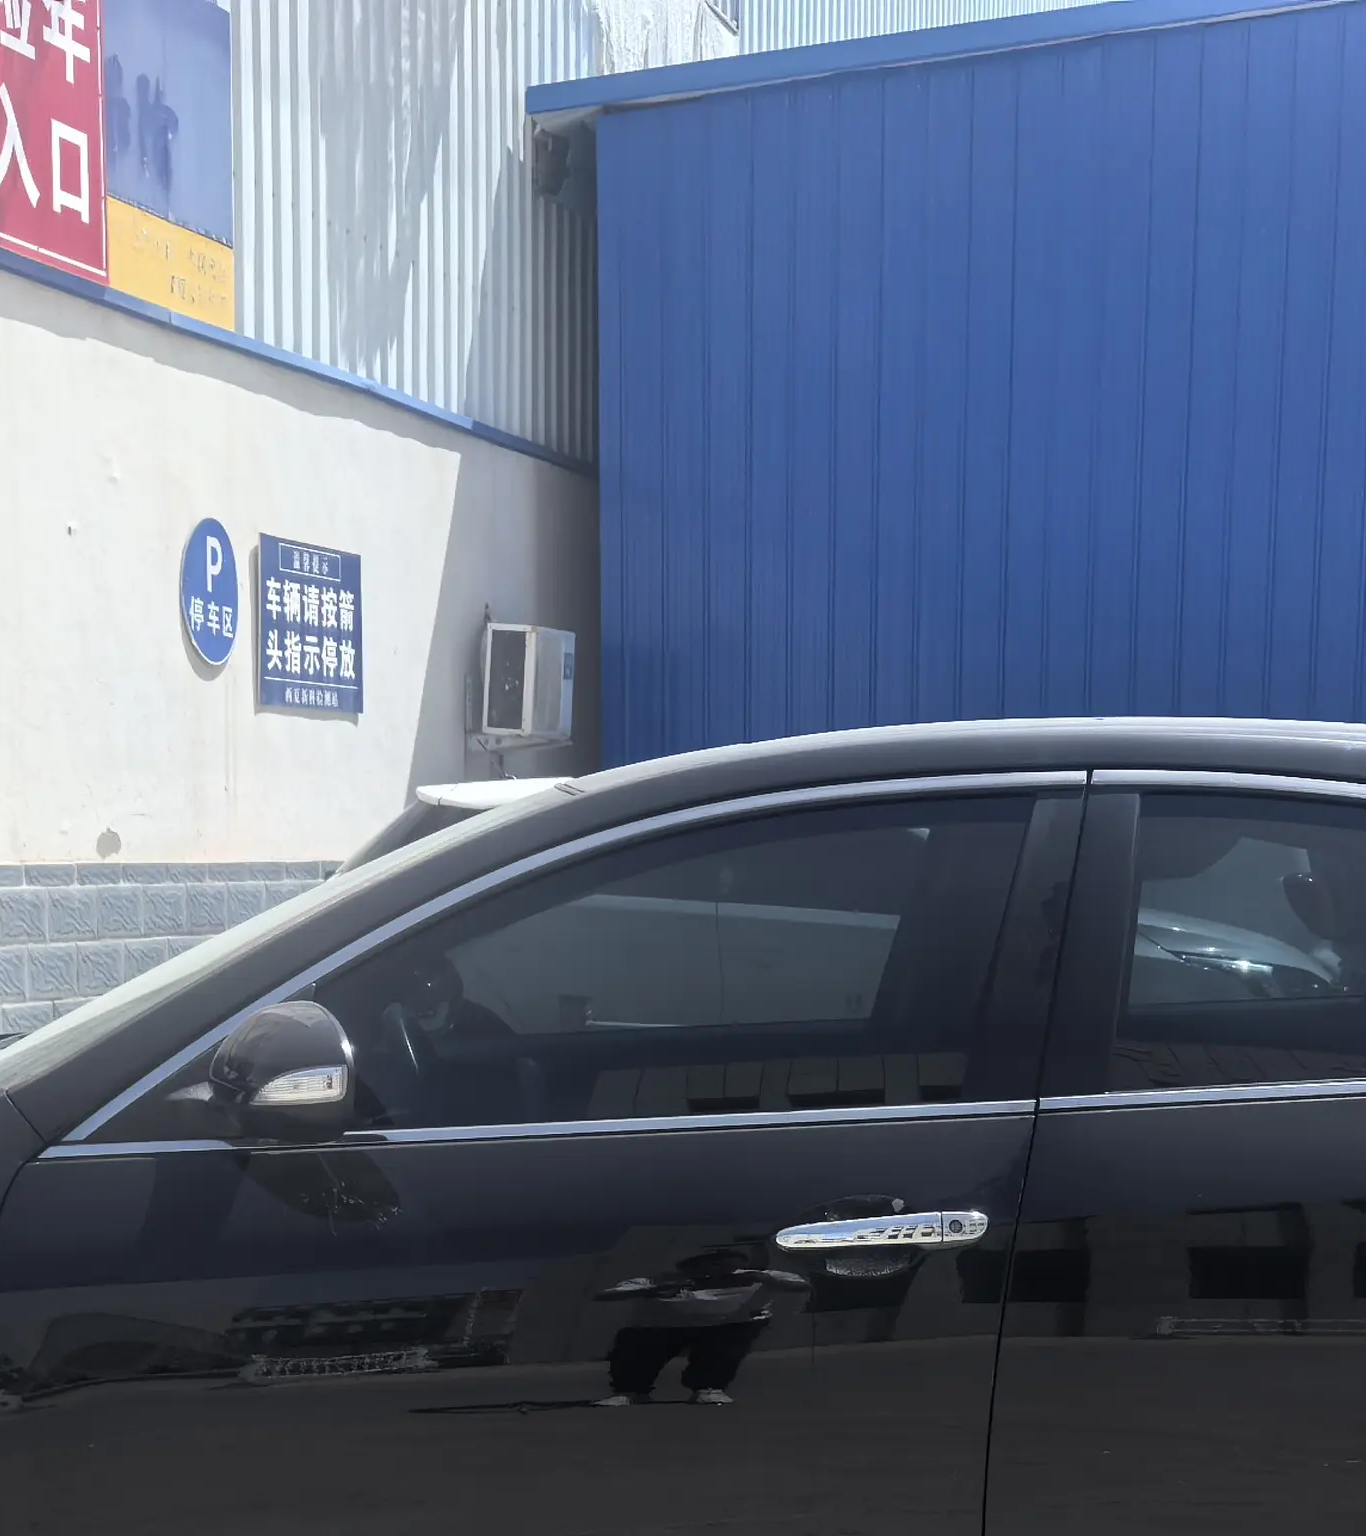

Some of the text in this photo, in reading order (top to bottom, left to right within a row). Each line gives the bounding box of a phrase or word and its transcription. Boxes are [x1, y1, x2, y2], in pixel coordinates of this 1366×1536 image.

[206, 535, 223, 593] P
[189, 595, 235, 639] 停车区
[265, 576, 355, 632] 车辆请按箭
[265, 629, 356, 681] 头指示停放
